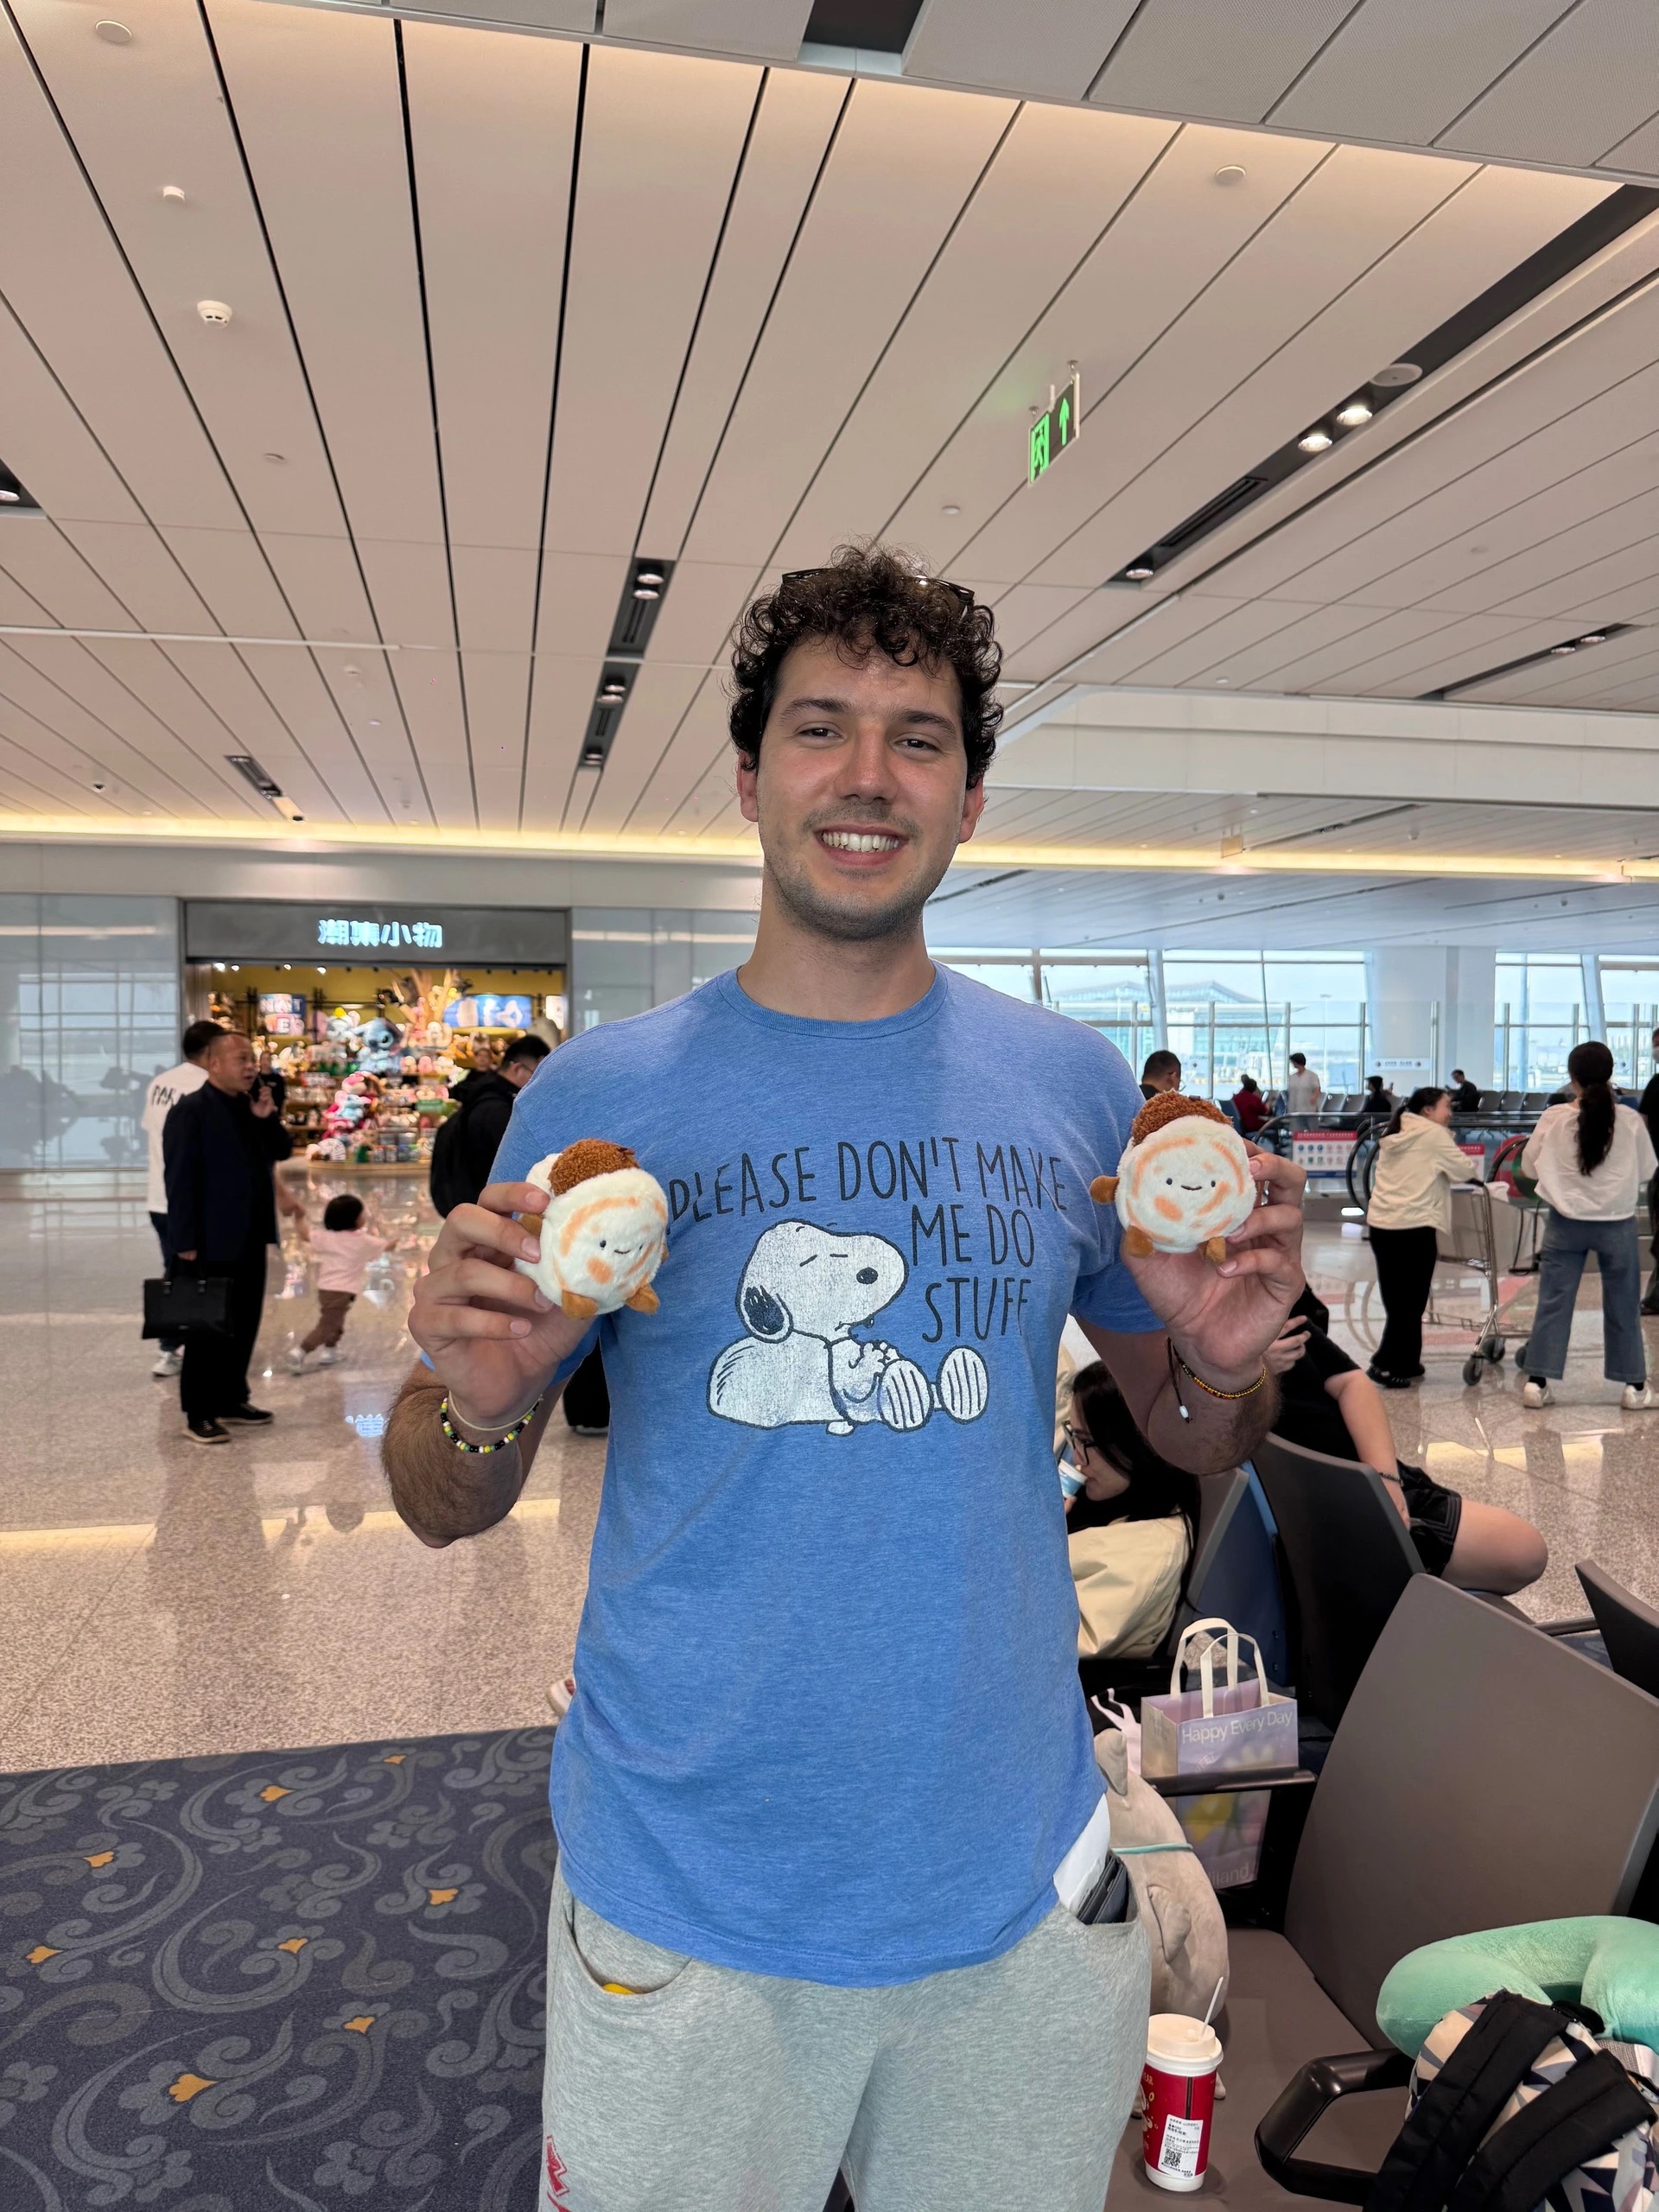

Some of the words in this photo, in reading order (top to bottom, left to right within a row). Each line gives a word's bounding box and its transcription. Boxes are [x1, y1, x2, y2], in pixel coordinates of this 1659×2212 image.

[666, 1147, 817, 1235] PLEASE
[837, 1136, 961, 1202] DON'T
[976, 1141, 1067, 1211] MAKE
[912, 1204, 972, 1267] ME
[986, 1204, 1035, 1268] DO
[922, 1276, 1032, 1343] STUFF
[1181, 1724, 1228, 1745] Happy
[1230, 1716, 1265, 1736] Every
[1267, 1710, 1294, 1726] Day
